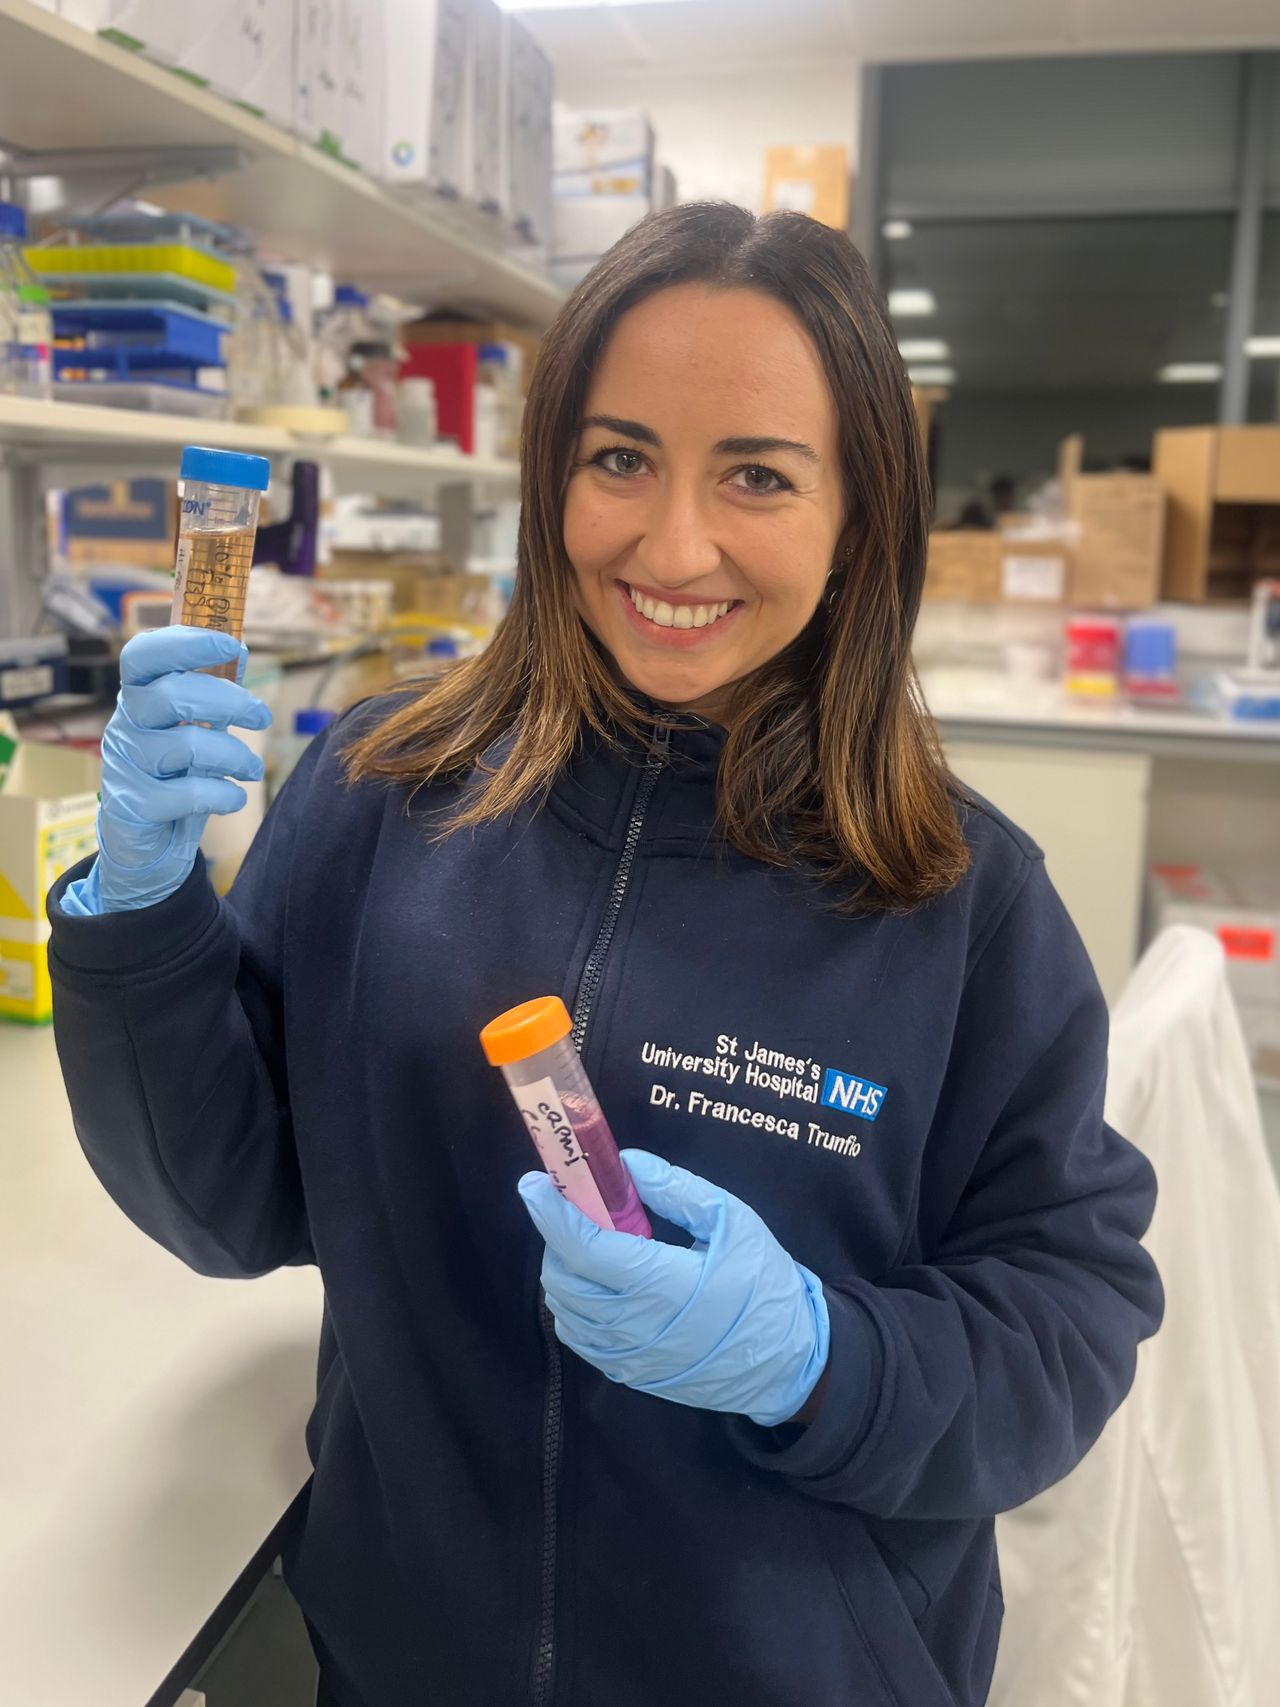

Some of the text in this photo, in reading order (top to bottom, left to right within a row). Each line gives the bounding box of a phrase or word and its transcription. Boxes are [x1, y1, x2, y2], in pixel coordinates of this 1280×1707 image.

[641, 1042, 819, 1104] University Hospital
[716, 1034, 821, 1080] St James's
[650, 1084, 862, 1158] Dr. Francesca Trunfio
[828, 1075, 883, 1117] NHS
